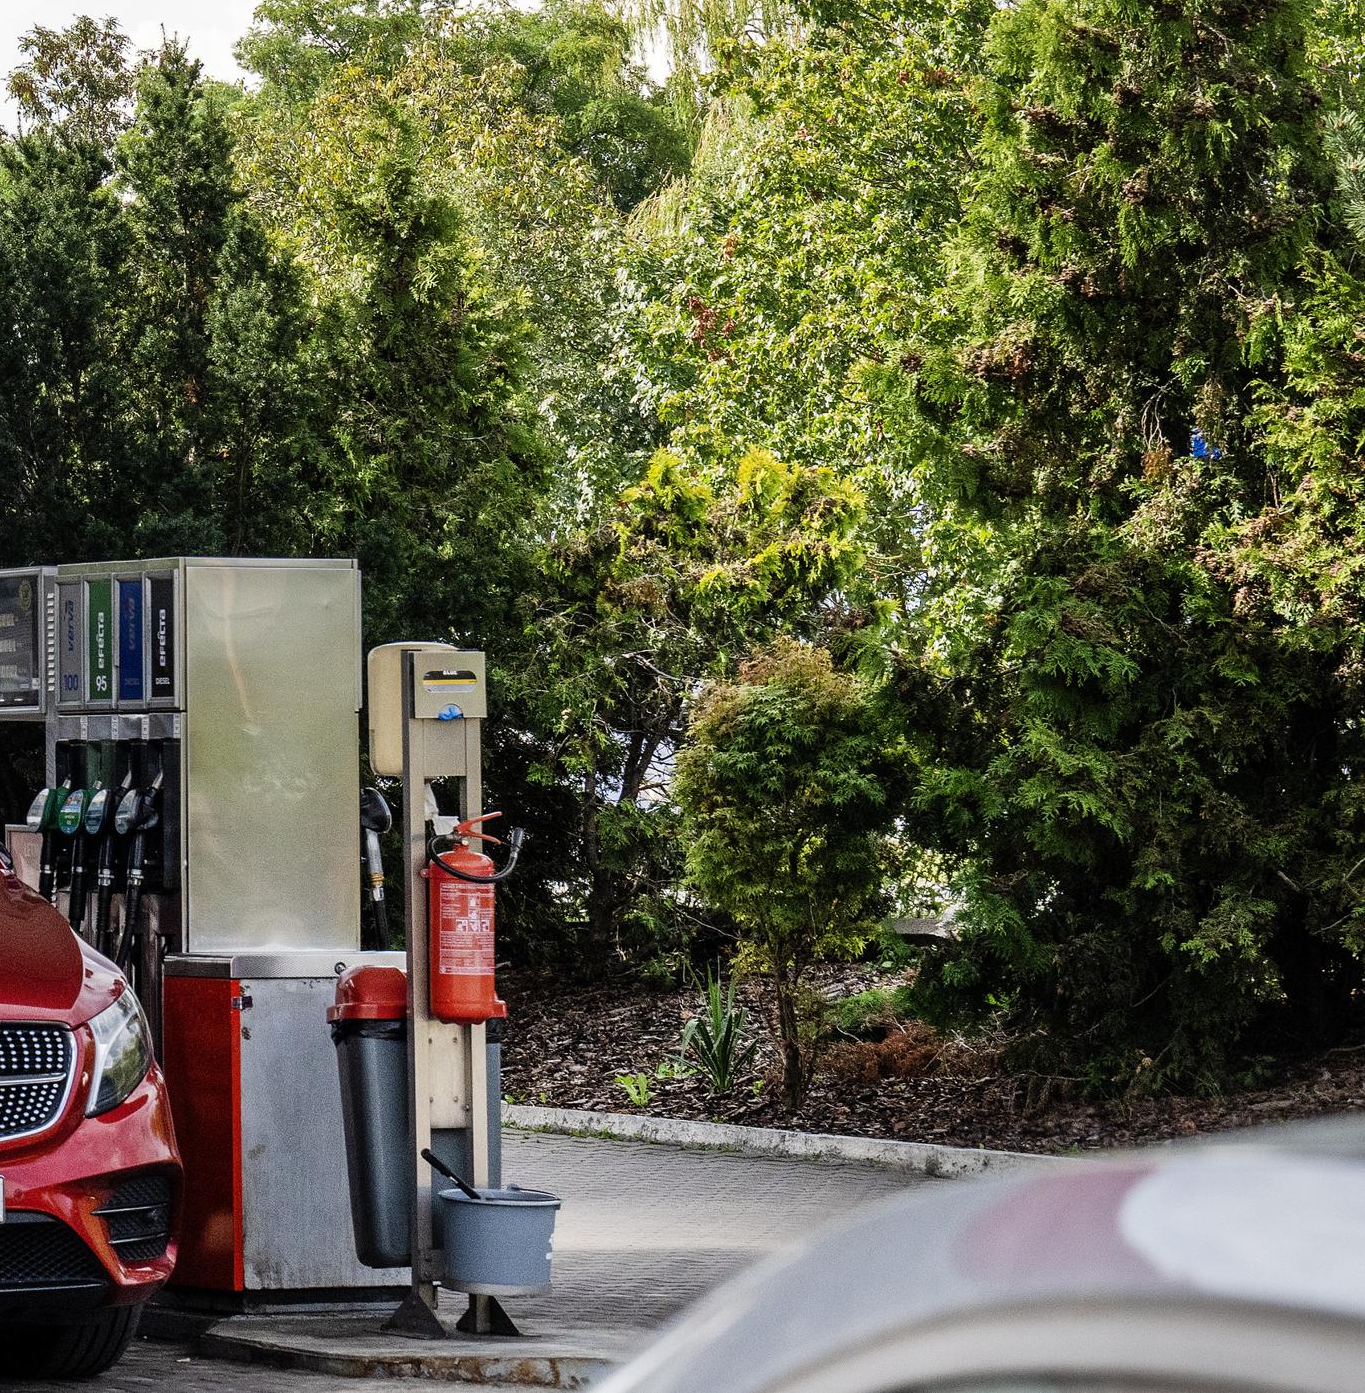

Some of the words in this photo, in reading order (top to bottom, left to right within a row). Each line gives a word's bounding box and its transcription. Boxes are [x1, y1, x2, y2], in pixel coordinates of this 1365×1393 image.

[97, 612, 105, 669] efecta
[158, 609, 166, 667] efecta
[96, 675, 107, 692] 95
